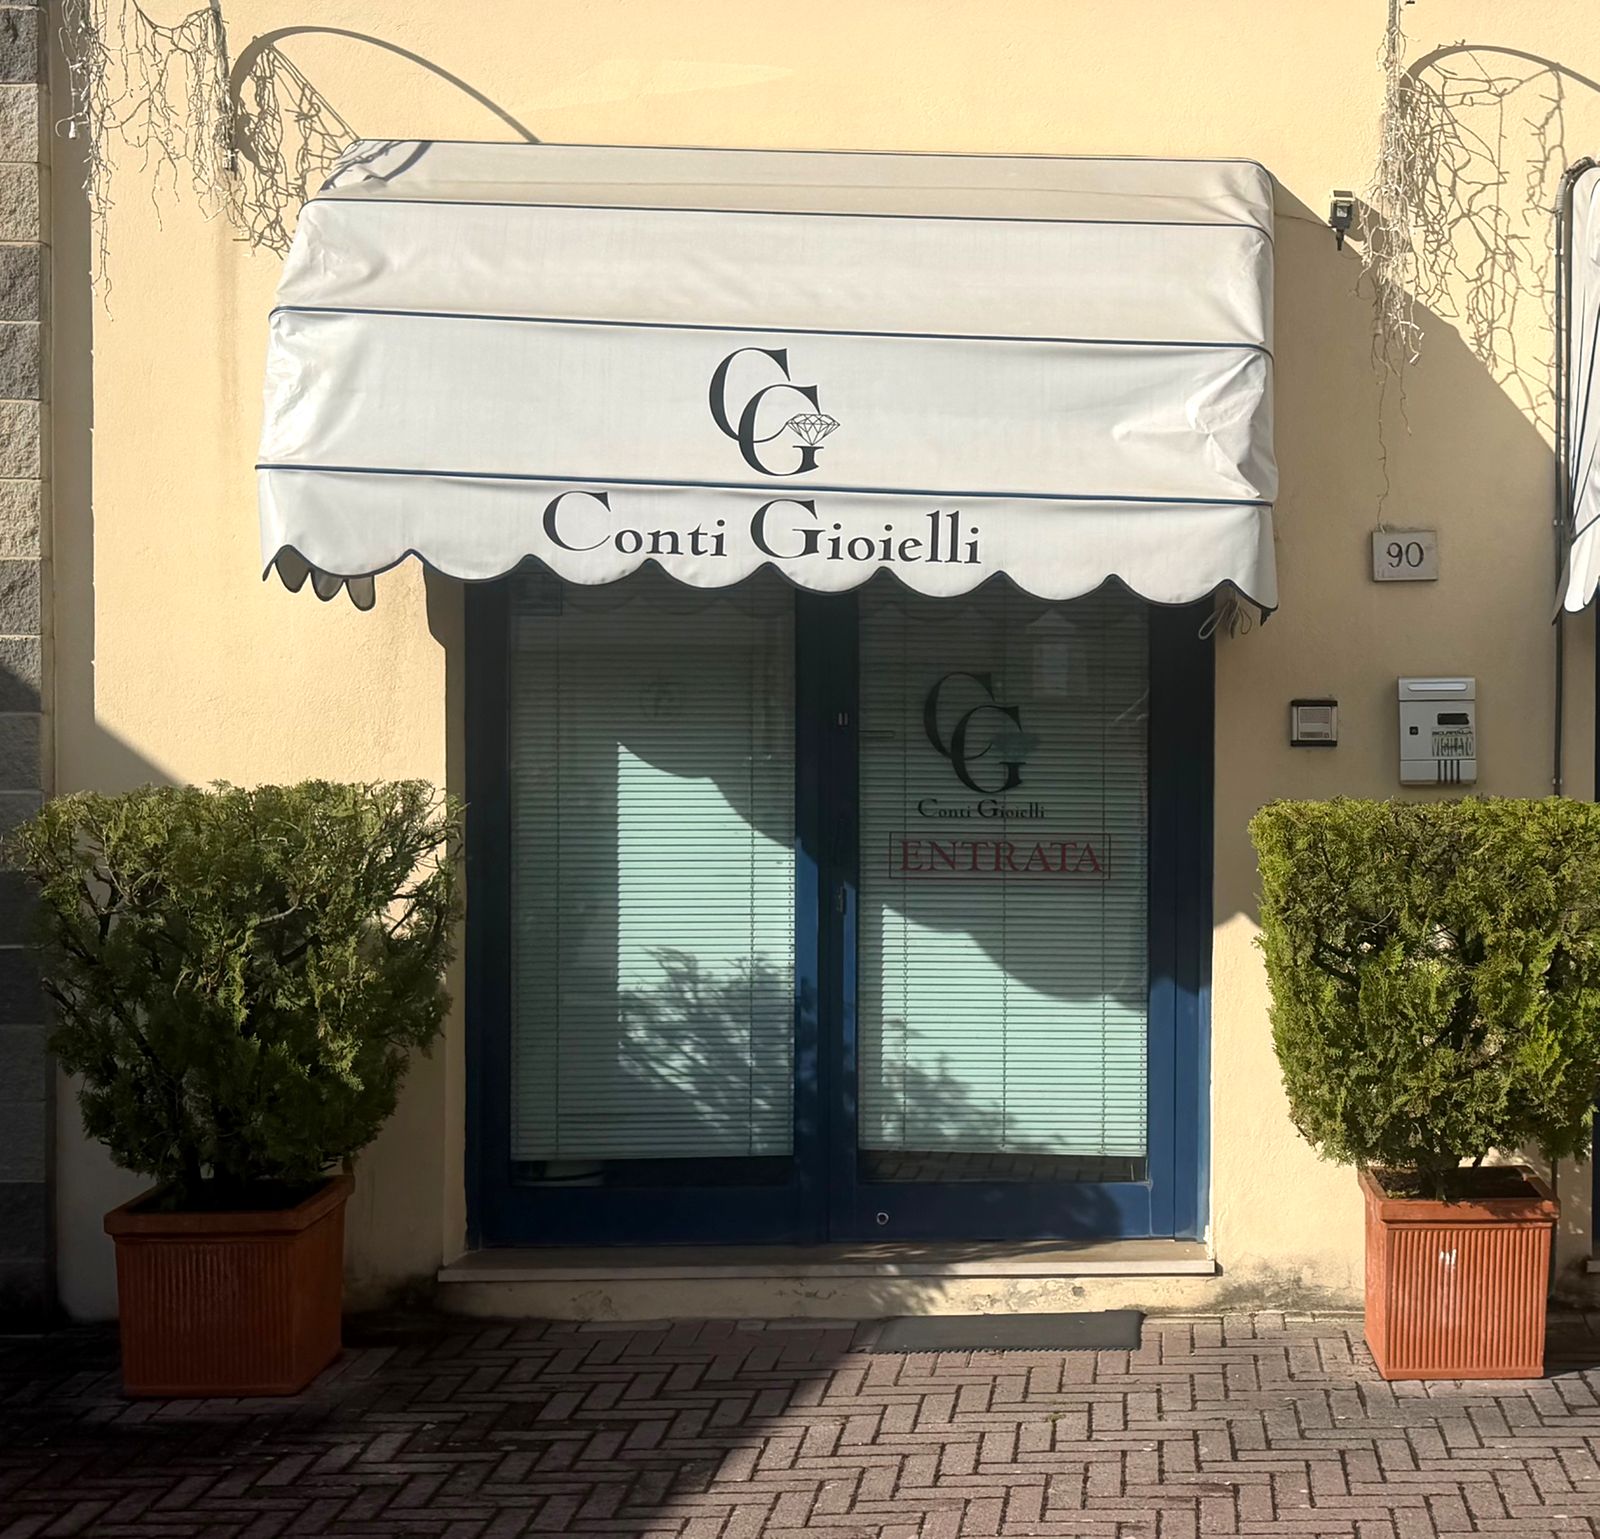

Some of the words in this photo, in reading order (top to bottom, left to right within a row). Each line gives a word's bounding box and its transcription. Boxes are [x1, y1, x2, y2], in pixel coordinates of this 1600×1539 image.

[543, 491, 727, 557] Conti
[750, 498, 982, 564] Gioielli
[1387, 542, 1424, 567] 90
[917, 798, 971, 818] Conti
[977, 799, 1045, 819] Gioielli
[901, 840, 1104, 873] ENTRATA
